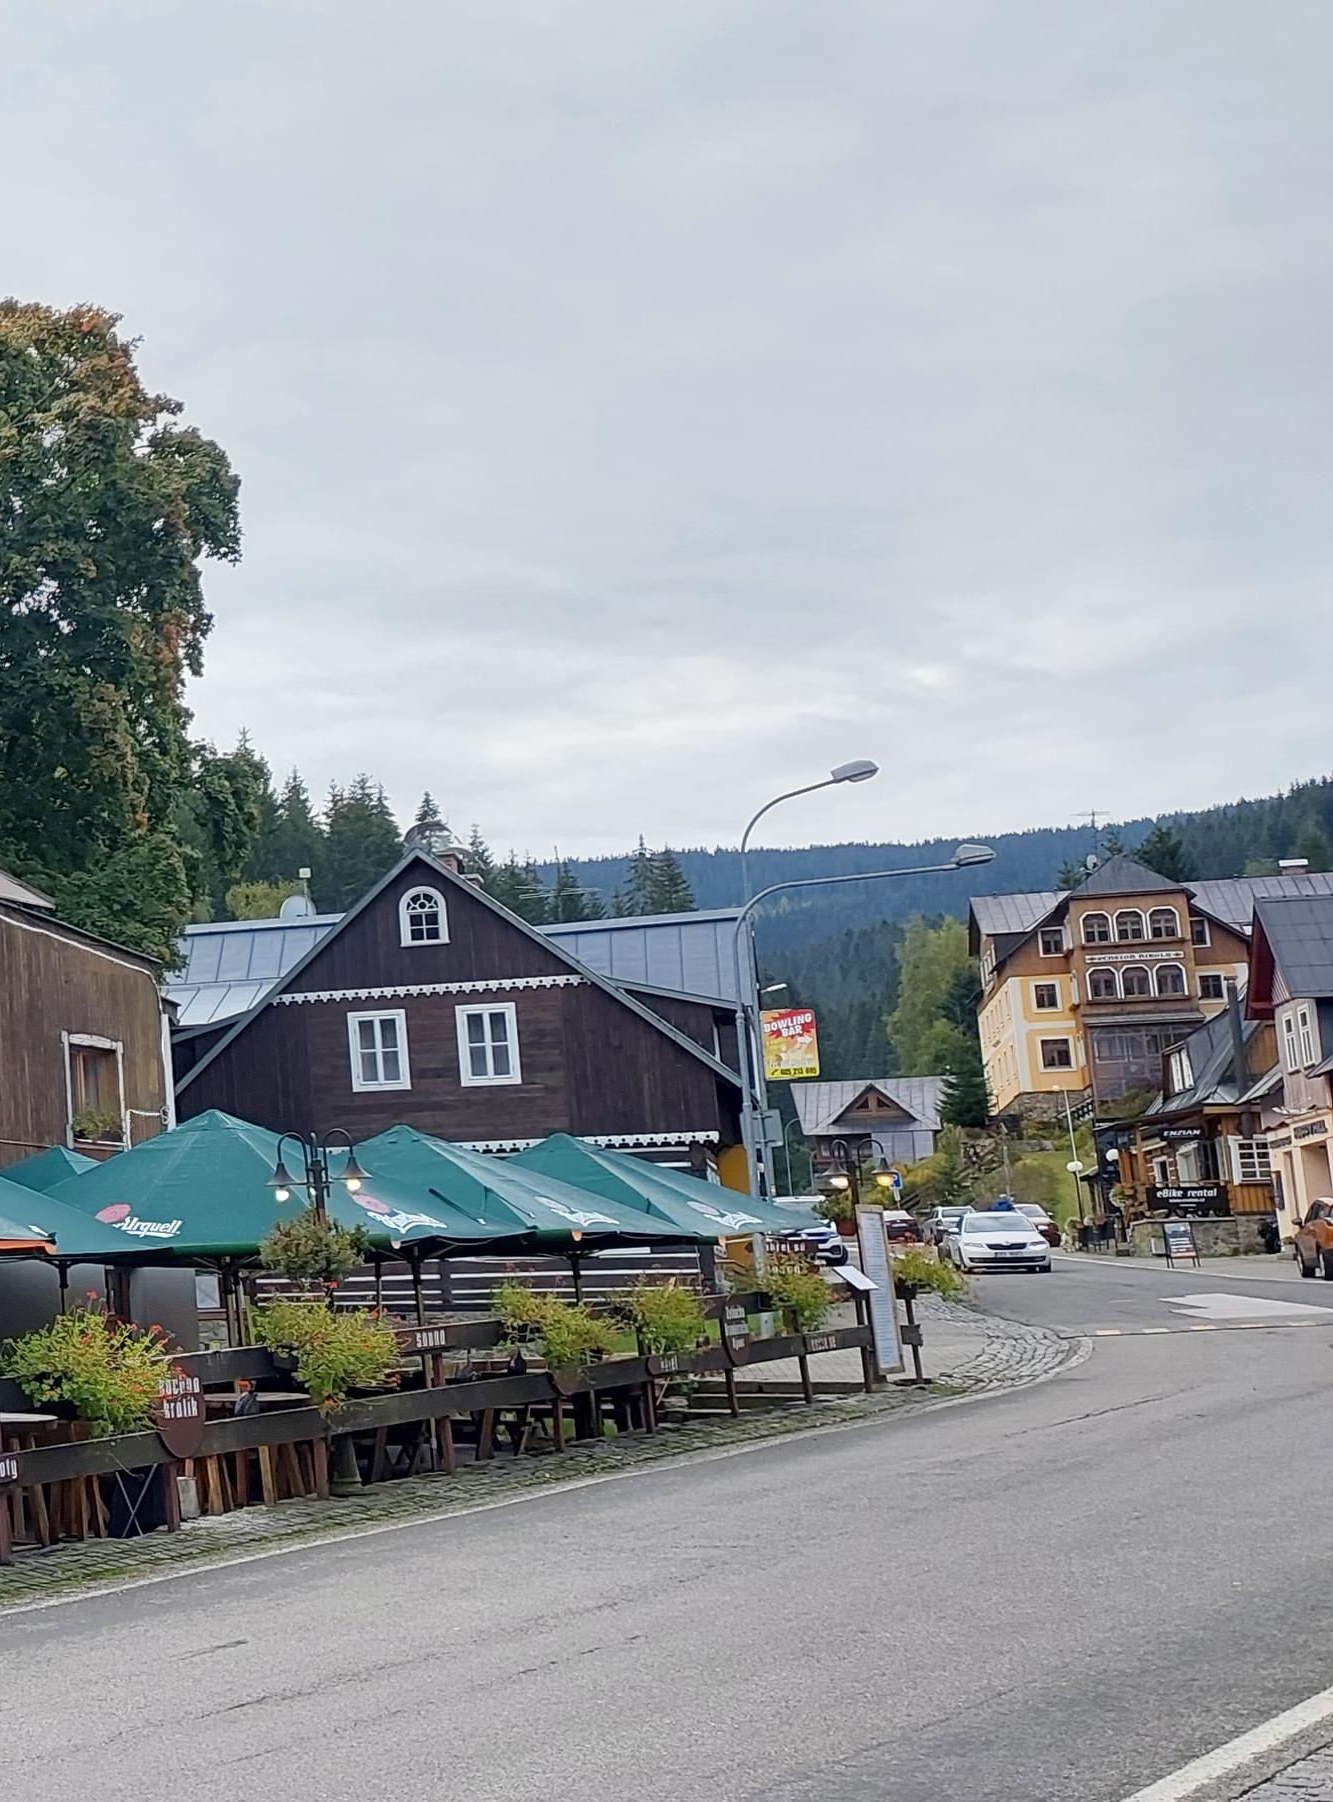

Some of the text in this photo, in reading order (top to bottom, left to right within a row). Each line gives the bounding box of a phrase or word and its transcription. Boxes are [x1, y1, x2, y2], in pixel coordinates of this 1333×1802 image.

[762, 1012, 812, 1033] BOWLING
[781, 1025, 803, 1037] BAR
[1163, 1129, 1201, 1137] ENZIAN
[1156, 1187, 1217, 1198] eBike rental
[163, 1395, 199, 1419] králík
